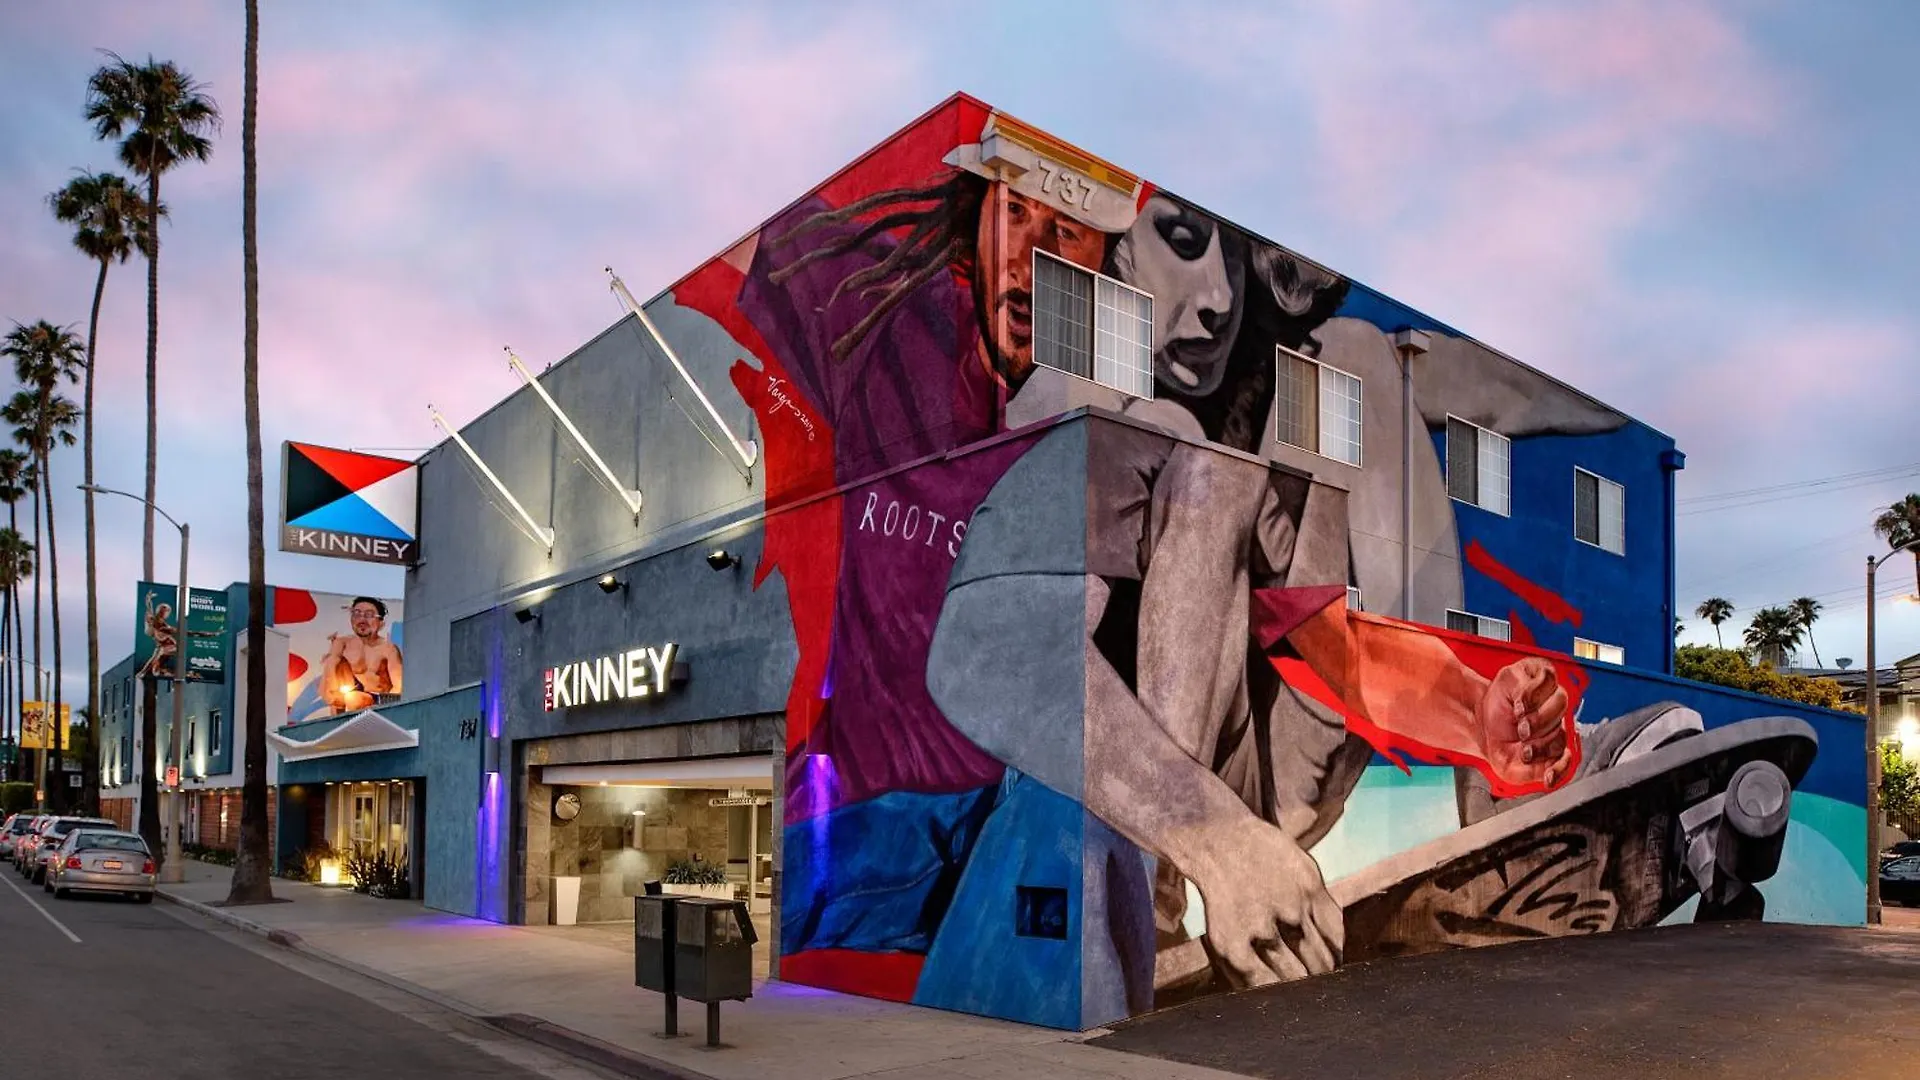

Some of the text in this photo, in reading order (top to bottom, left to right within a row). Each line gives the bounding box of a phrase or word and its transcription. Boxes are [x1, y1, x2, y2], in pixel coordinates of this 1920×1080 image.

[1037, 159, 1098, 212] 737
[298, 529, 410, 560] KINNEY
[859, 491, 968, 559] ROOTS
[544, 642, 677, 712] THE KINNEY
